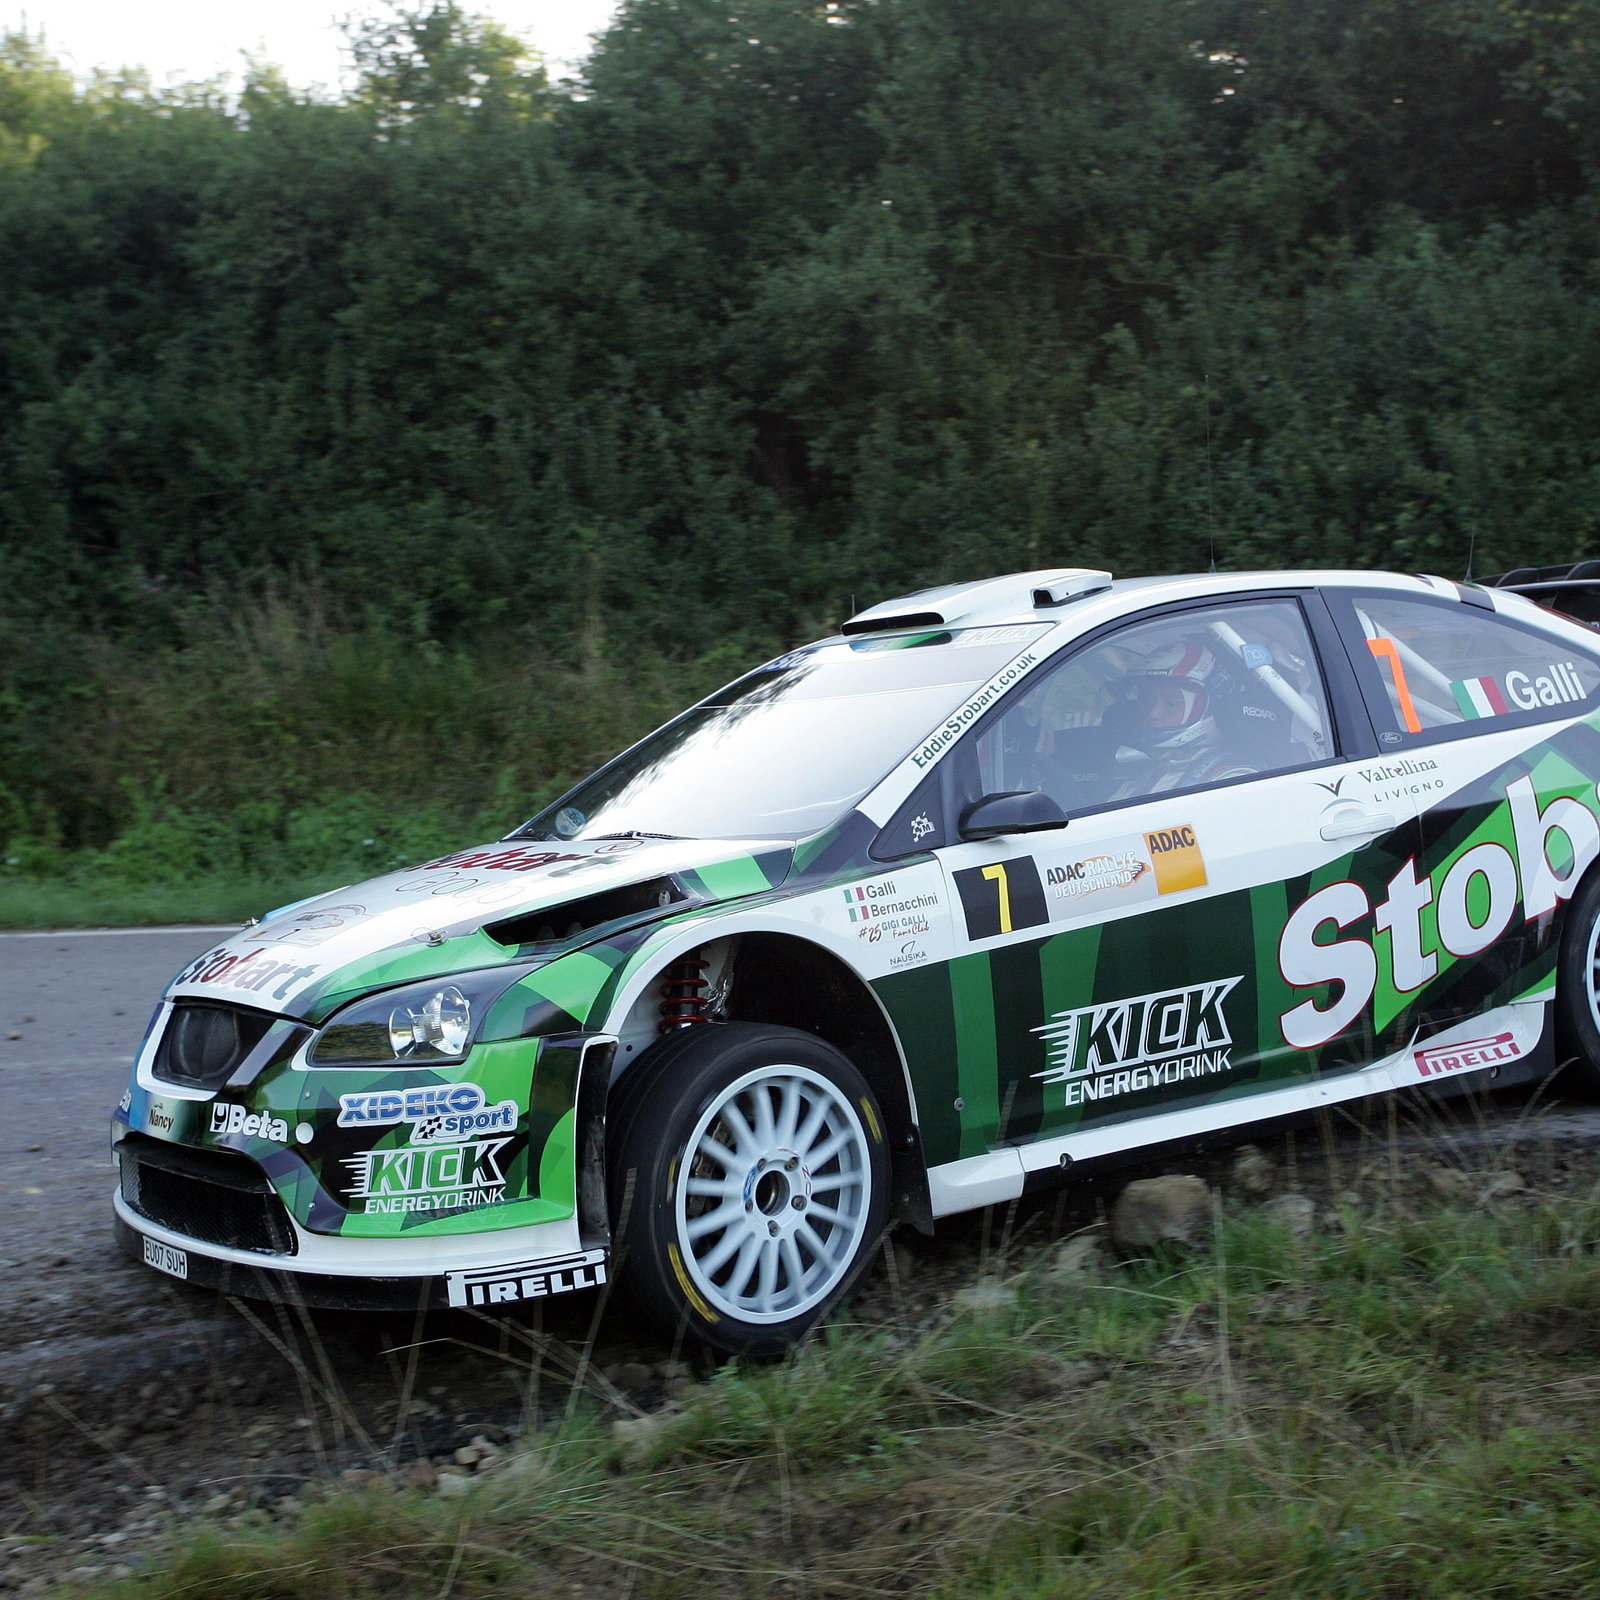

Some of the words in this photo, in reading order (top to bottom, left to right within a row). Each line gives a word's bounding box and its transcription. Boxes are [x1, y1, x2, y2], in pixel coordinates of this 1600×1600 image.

[1366, 637, 1423, 733] 7
[1505, 661, 1587, 711] Galli
[911, 652, 1038, 769] EddieStobart.co.uk
[1243, 706, 1277, 722] RECARO
[1357, 757, 1439, 785] Valtellina
[1373, 779, 1445, 803] LIVIGNO
[1149, 827, 1196, 855] ADAC
[1046, 861, 1086, 886] ADAC
[1085, 851, 1136, 877] RALLYE
[1055, 870, 1133, 900] DEUTSCHLAND
[866, 880, 897, 899] Galli
[871, 892, 939, 917] Bernacchini
[981, 863, 1013, 934] 7
[881, 919, 900, 932] GIGI
[901, 913, 926, 927] GALLI
[1278, 773, 1600, 1051] Stob
[175, 947, 322, 1001] Stobart
[889, 949, 928, 966] NAUSIKA
[1040, 975, 1244, 1083] KICK
[1413, 1032, 1521, 1077] PIRELLI
[1064, 1048, 1232, 1107] ENERGYDRINK
[150, 1108, 175, 1134] Nancy
[226, 1104, 289, 1144] Beta
[340, 1087, 482, 1124] XIDEKO
[444, 1105, 513, 1135] sport
[346, 1136, 515, 1197] KICK
[364, 1186, 507, 1215] ENERGYDRINK
[145, 1239, 165, 1267] EU07
[165, 1248, 186, 1276] SUH
[446, 1248, 607, 1308] PIRELLI
